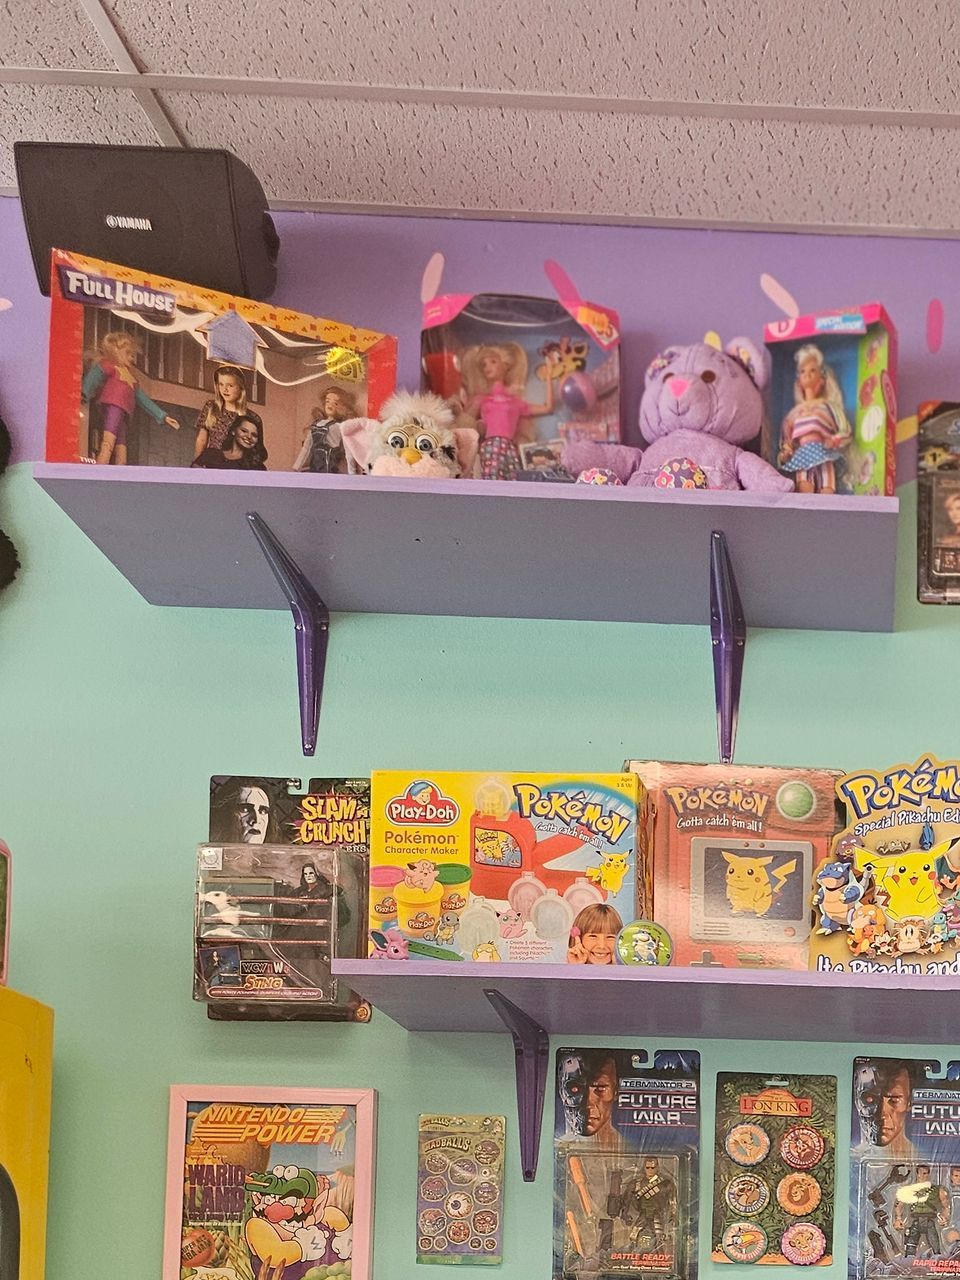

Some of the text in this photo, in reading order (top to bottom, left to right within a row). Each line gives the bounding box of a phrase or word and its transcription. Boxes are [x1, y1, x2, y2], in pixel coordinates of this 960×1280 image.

[117, 215, 152, 231] YAMAHA
[66, 271, 175, 313] FULL HOUSE
[301, 796, 357, 821] SLAM
[390, 803, 455, 820] Play-Doh
[676, 816, 704, 830] Gotta
[705, 816, 729, 828] catch
[854, 812, 898, 836] Special
[898, 806, 942, 826] Pikachu
[300, 820, 367, 845] CRUNCH
[384, 830, 456, 845] Pokémon
[384, 845, 459, 855] Character Maker
[928, 954, 960, 977] and
[244, 974, 284, 990] STING
[622, 1080, 685, 1089] TERMINATOR
[618, 1094, 697, 1109] FUTURE
[743, 1100, 810, 1113] LION KING
[200, 1106, 305, 1123] NINTENDO
[633, 1111, 680, 1125] WAR
[240, 1124, 336, 1143] POWER
[188, 1164, 246, 1187] WARIO
[188, 1187, 246, 1213] LAND
[912, 1259, 937, 1267] RAPID
